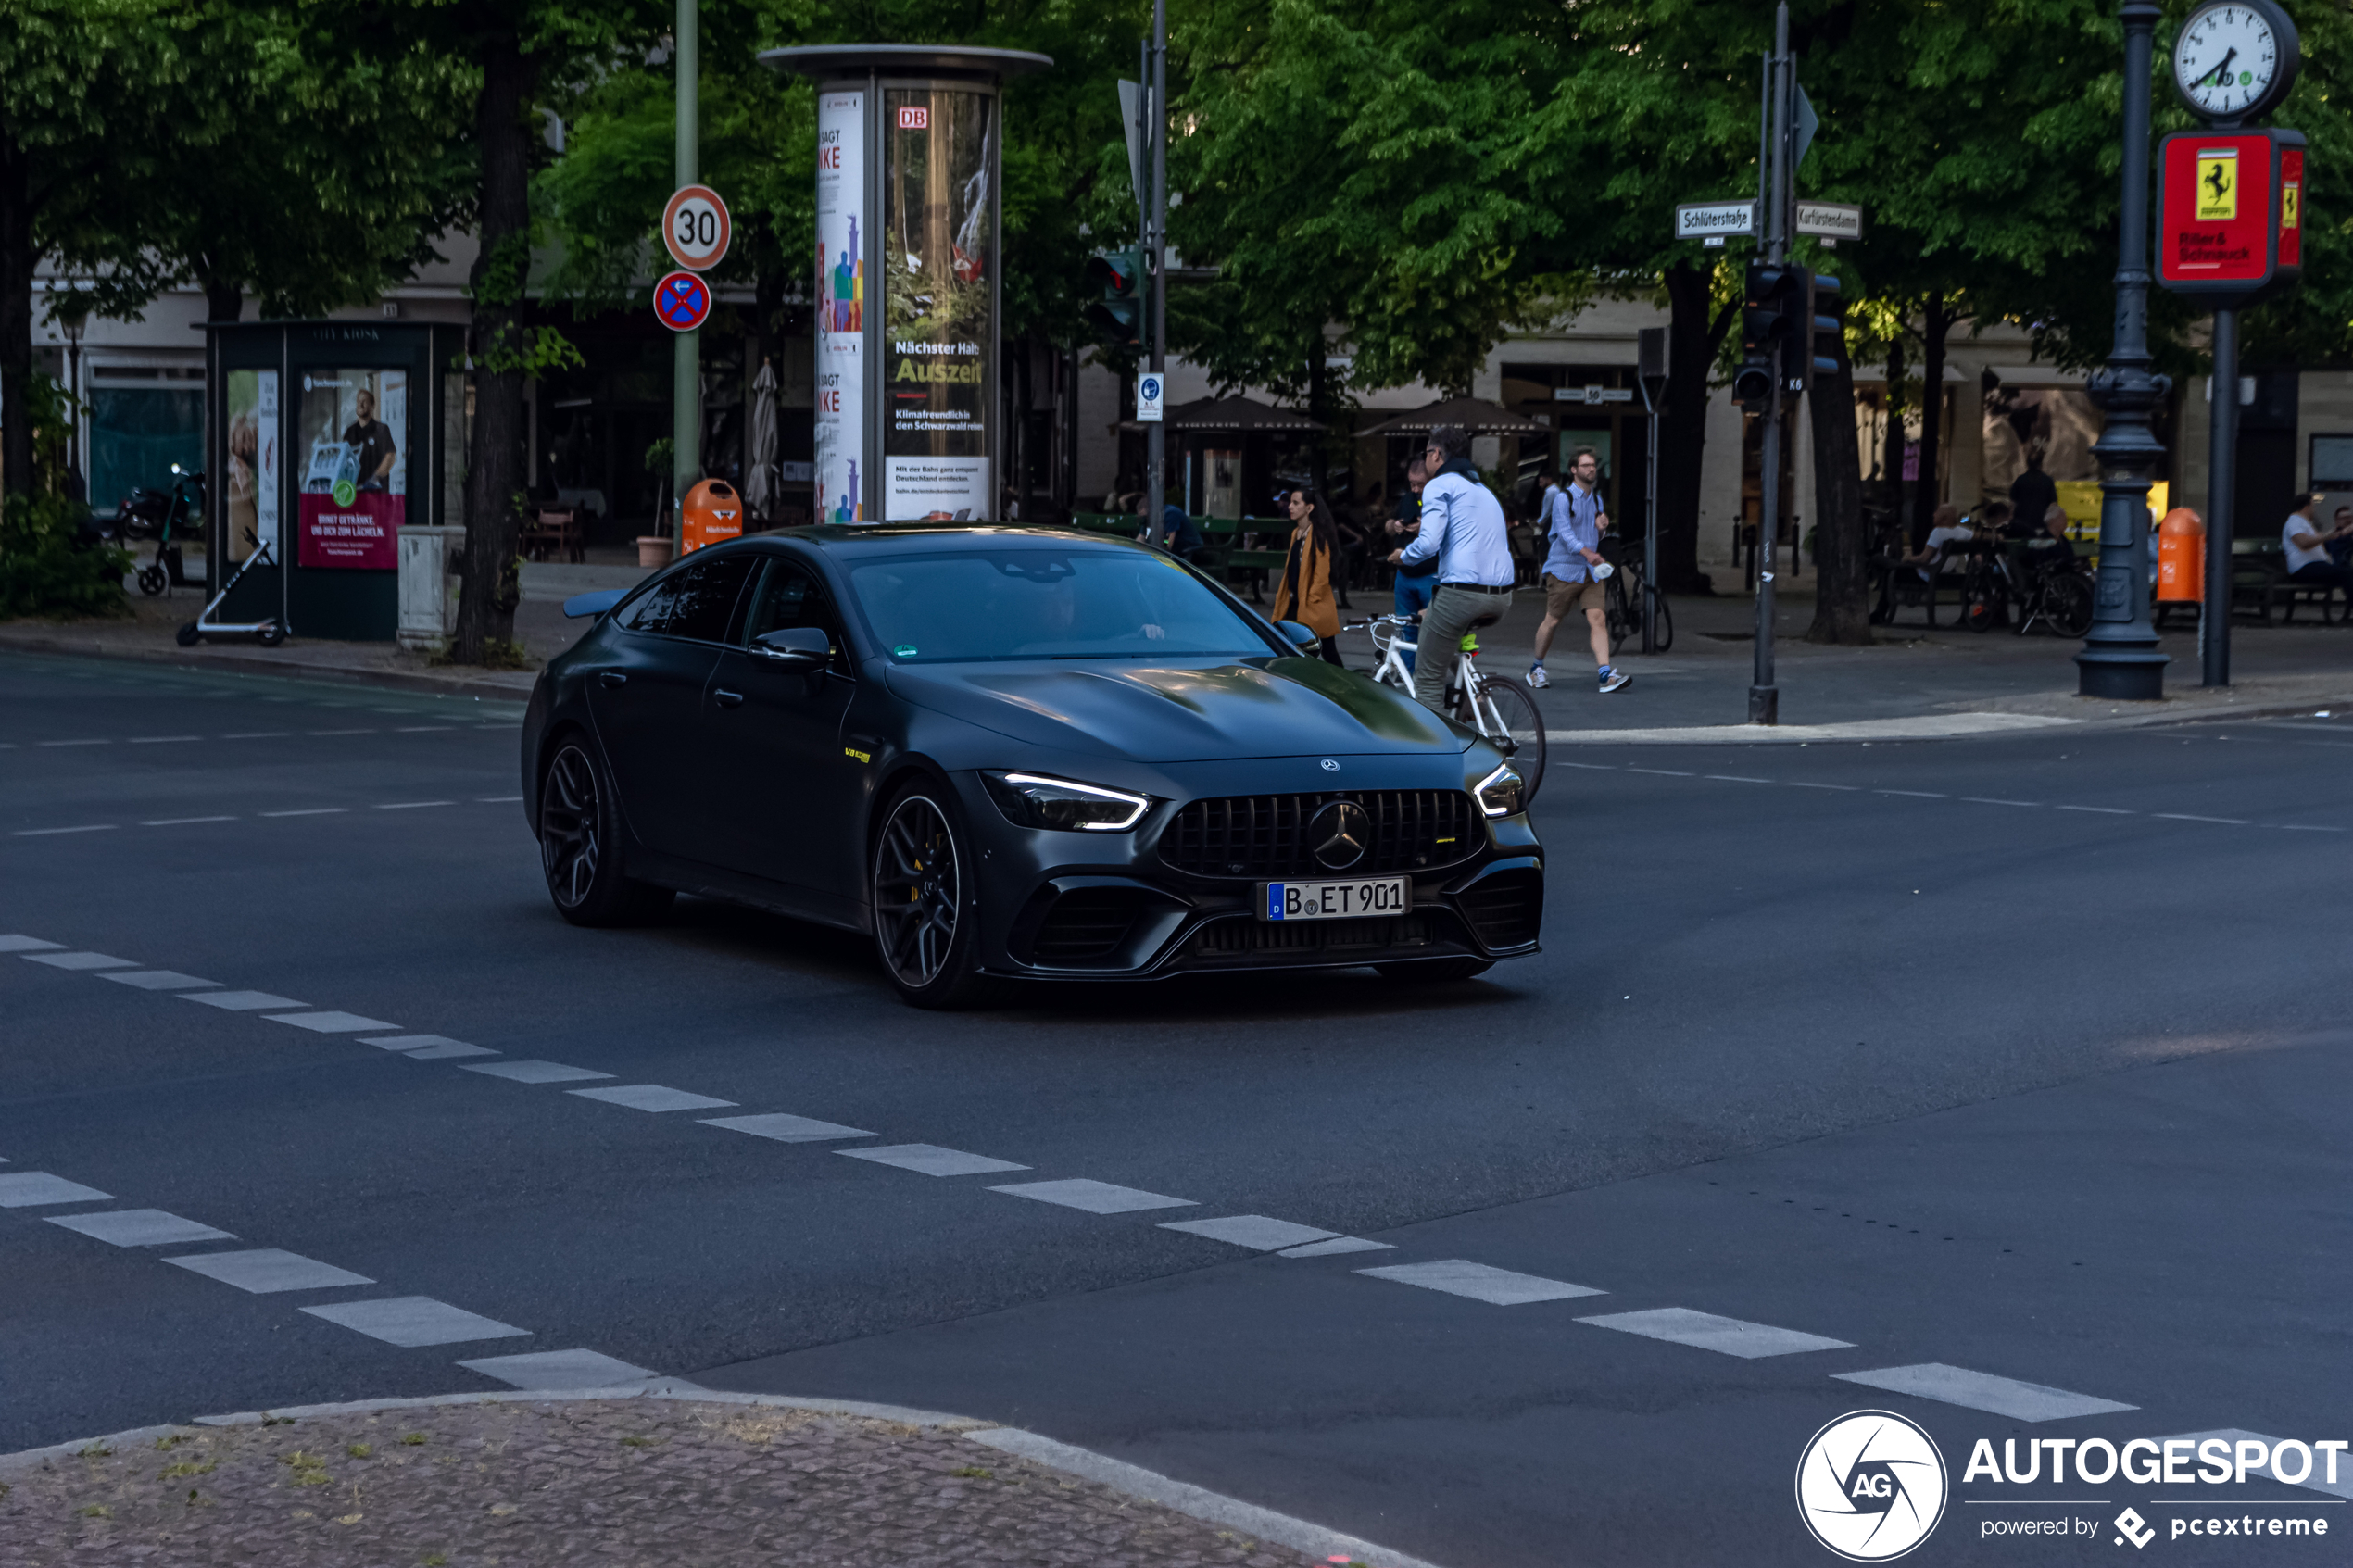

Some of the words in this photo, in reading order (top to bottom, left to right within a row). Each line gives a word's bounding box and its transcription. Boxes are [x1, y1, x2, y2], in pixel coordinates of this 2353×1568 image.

[901, 110, 925, 125] DB
[1684, 208, 1747, 229] Schlüterstraße
[1798, 208, 1856, 229] Kurfürstendamm
[678, 208, 715, 245] 30
[2179, 247, 2249, 261] Schnauck
[343, 326, 379, 341] KIOSK
[895, 341, 957, 355] Nächster
[895, 358, 982, 383] Auszeit
[1789, 377, 1803, 391] K6
[895, 408, 963, 420] Klimafreundlich
[963, 409, 971, 420] in
[895, 420, 913, 431] den
[914, 420, 966, 431] Schwarzwald
[845, 746, 856, 758] V8
[1286, 887, 1302, 915] B
[1321, 885, 1353, 913] ET
[1359, 883, 1403, 912] 901
[1273, 905, 1280, 913] D
